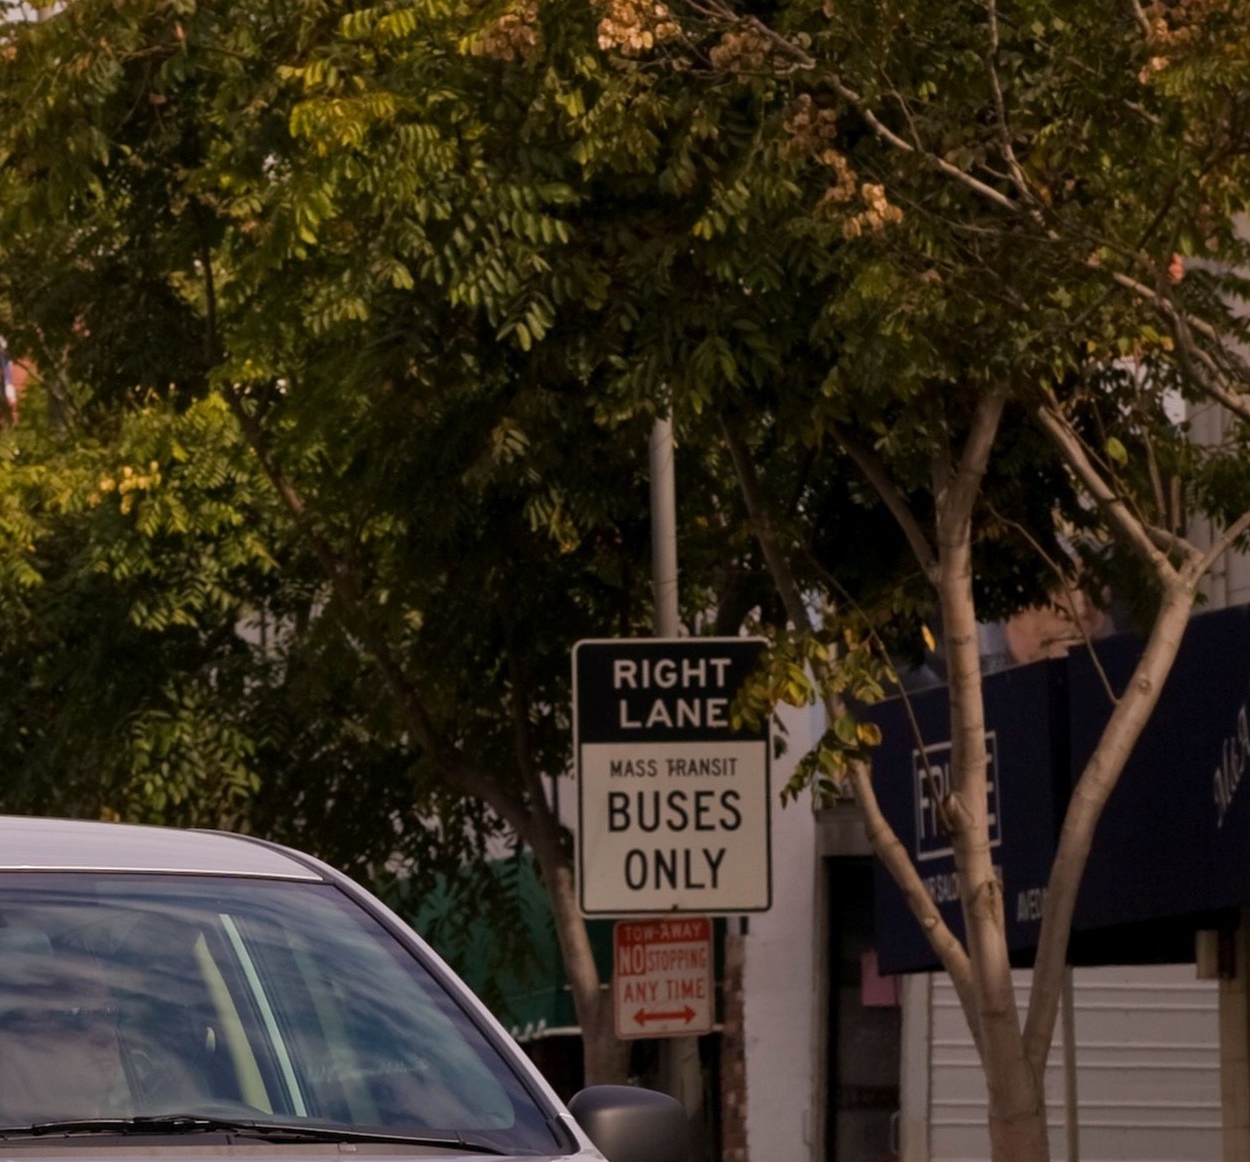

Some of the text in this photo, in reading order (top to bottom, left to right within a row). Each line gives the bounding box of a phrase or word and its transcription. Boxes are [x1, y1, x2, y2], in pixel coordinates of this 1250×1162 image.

[613, 658, 732, 690] RIGHT
[619, 699, 729, 729] LANE
[610, 757, 738, 778] MASS TRANSIT
[608, 790, 743, 833] BUSES
[624, 848, 727, 891] ONLY
[624, 922, 703, 942] TOW-AWAY
[618, 944, 707, 975] NO STOPPING
[623, 978, 705, 1004] ANY TIME
